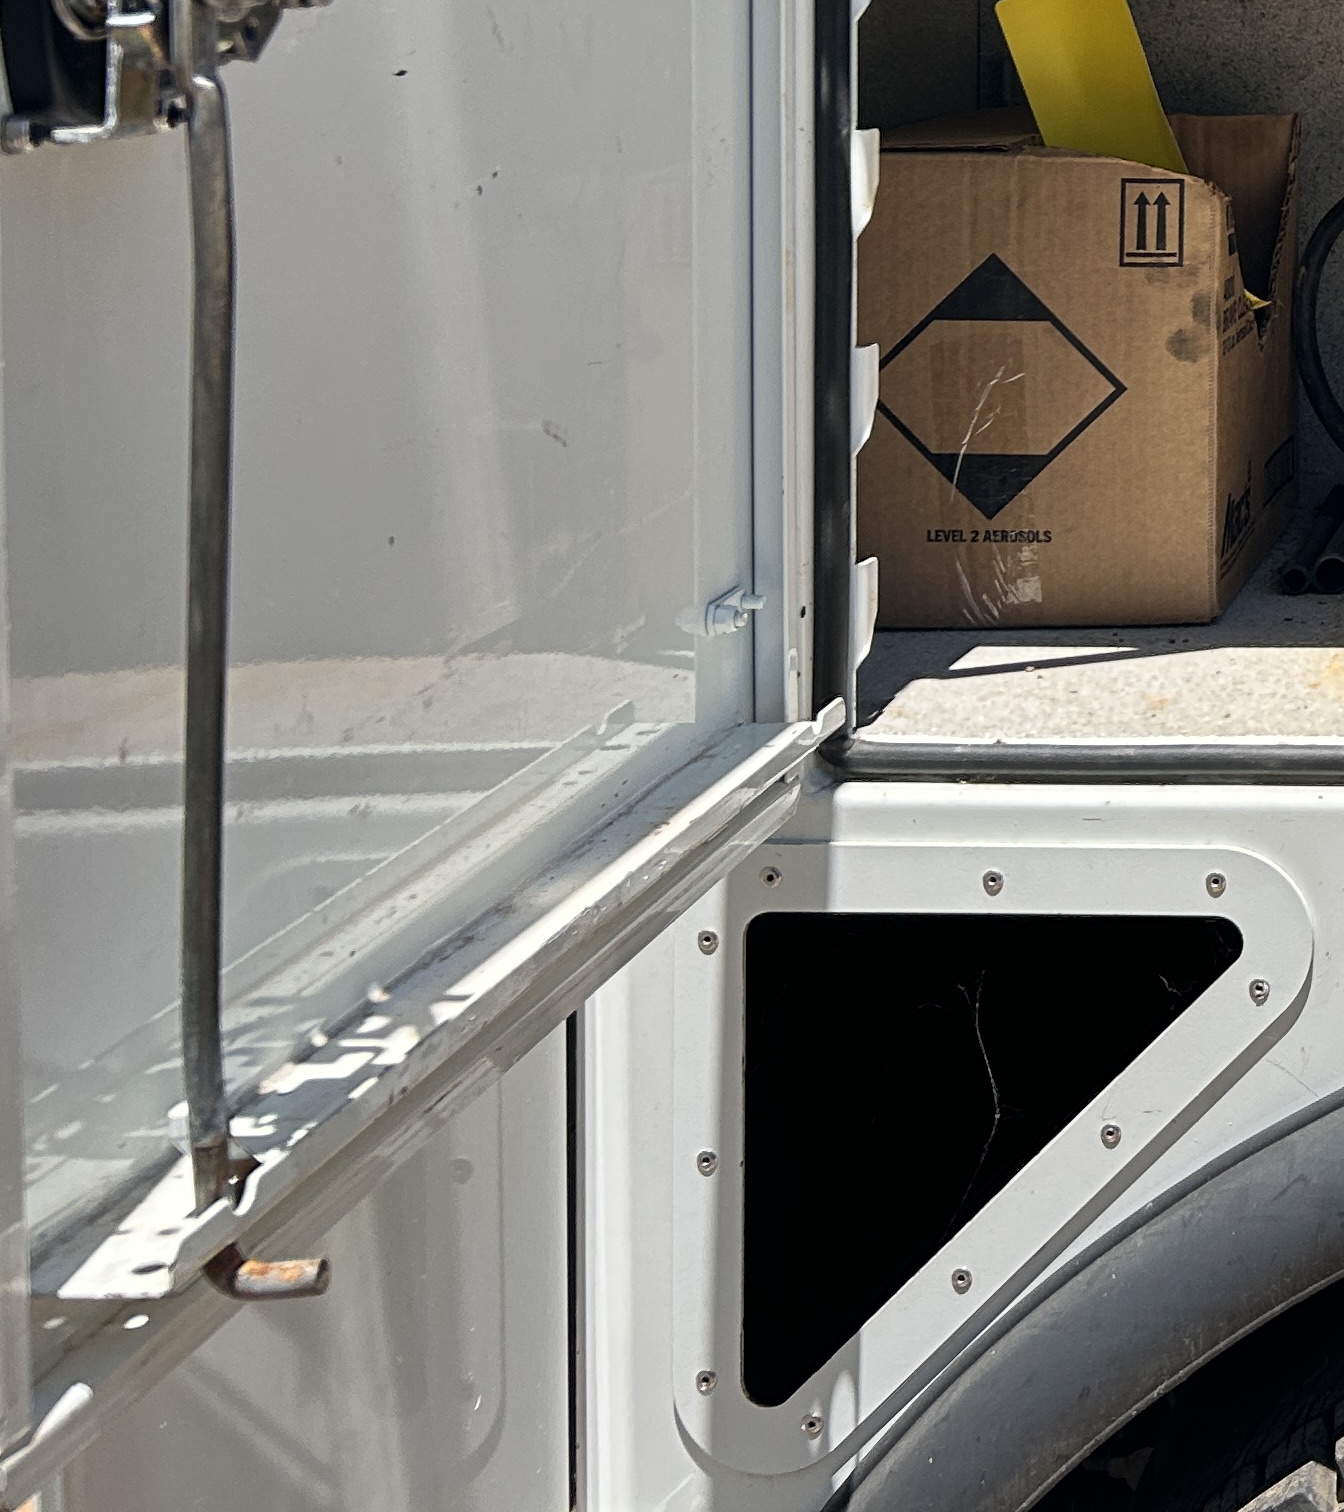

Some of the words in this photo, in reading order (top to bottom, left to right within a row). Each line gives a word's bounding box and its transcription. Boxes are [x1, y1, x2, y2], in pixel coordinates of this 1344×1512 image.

[926, 529, 966, 543] LEVEL
[970, 530, 979, 543] 2
[983, 529, 1052, 543] AEROSOLS
